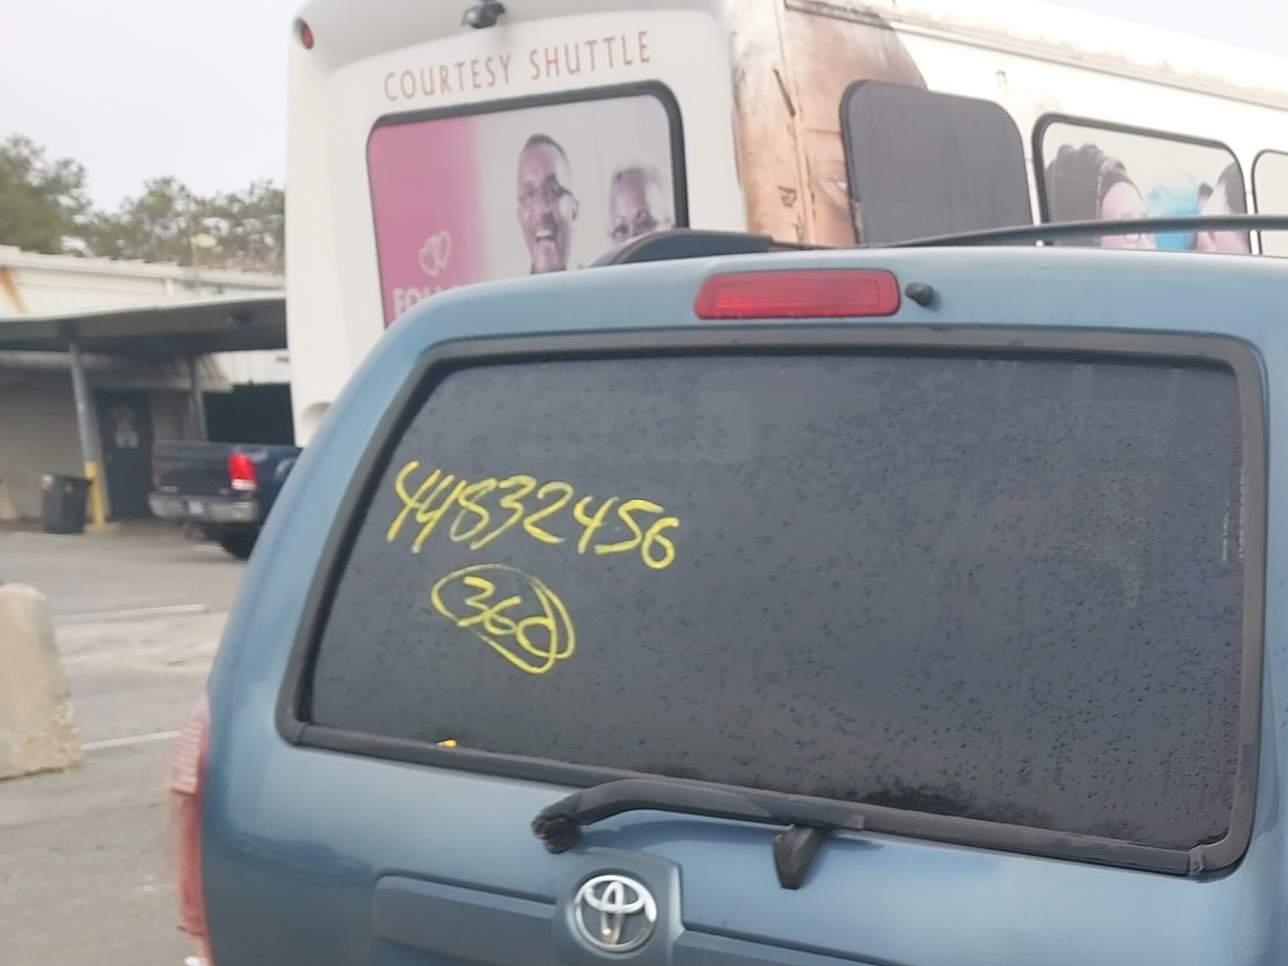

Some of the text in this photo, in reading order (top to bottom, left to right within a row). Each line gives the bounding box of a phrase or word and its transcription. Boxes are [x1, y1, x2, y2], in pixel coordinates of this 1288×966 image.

[384, 30, 652, 102] COURTESY SHUTTLE
[386, 459, 681, 570] 44832456
[457, 574, 558, 661] 360
